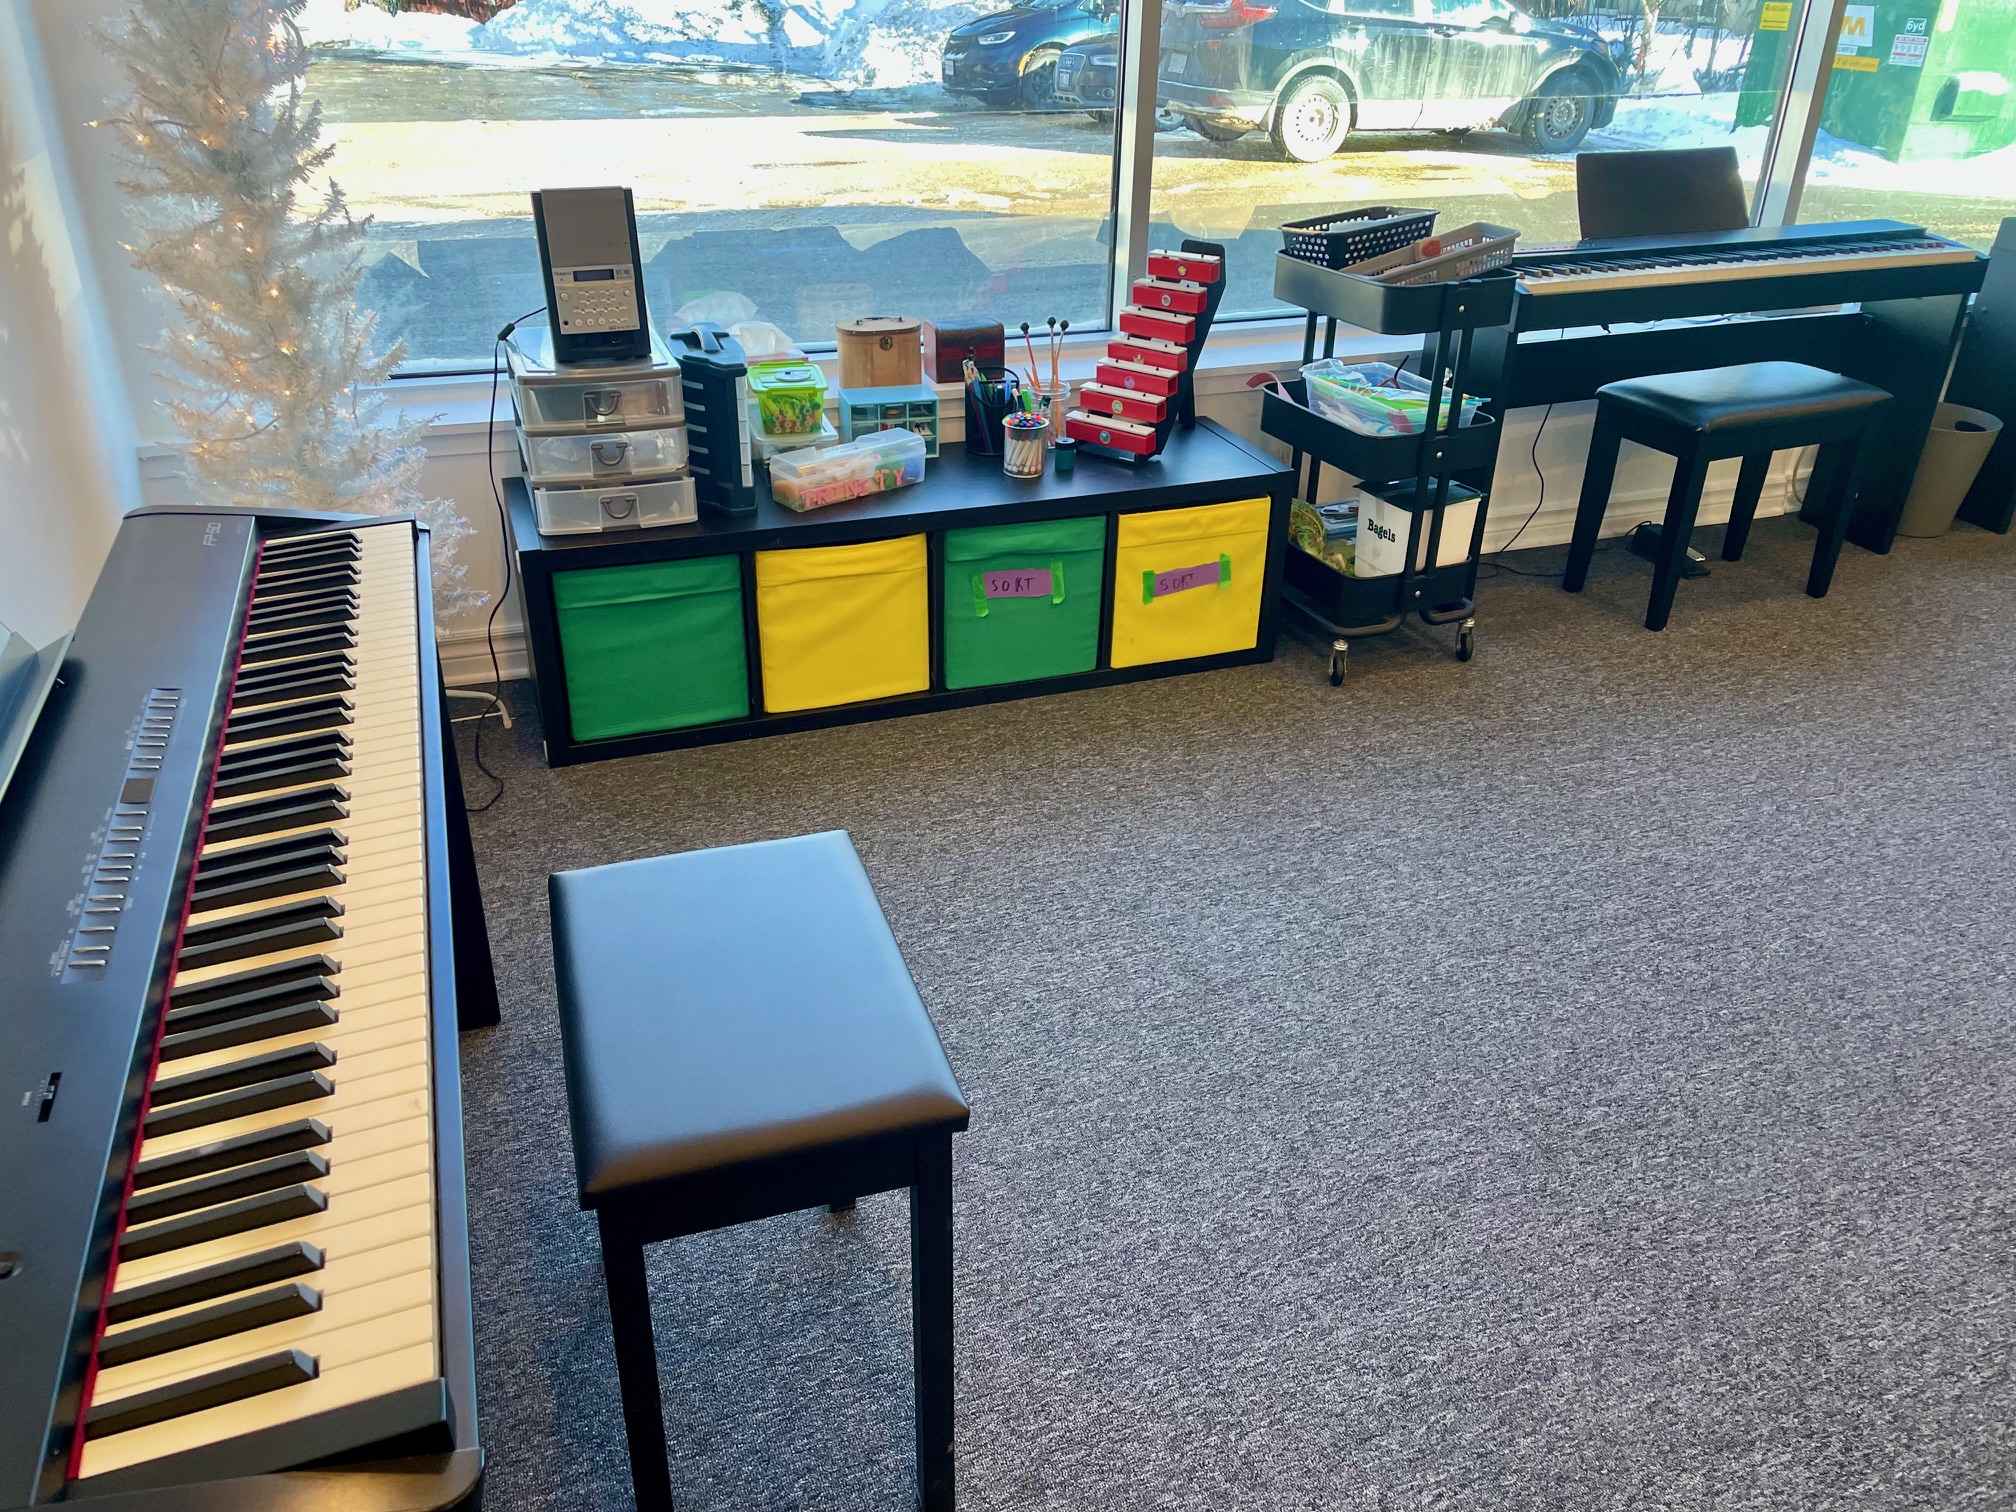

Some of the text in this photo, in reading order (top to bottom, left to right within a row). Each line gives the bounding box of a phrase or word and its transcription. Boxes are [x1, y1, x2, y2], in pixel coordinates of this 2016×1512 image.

[1907, 20, 1926, 32] 6yd
[1367, 518, 1396, 543] Bagels
[991, 576, 1035, 592] SORT
[1160, 572, 1195, 591] SORT
